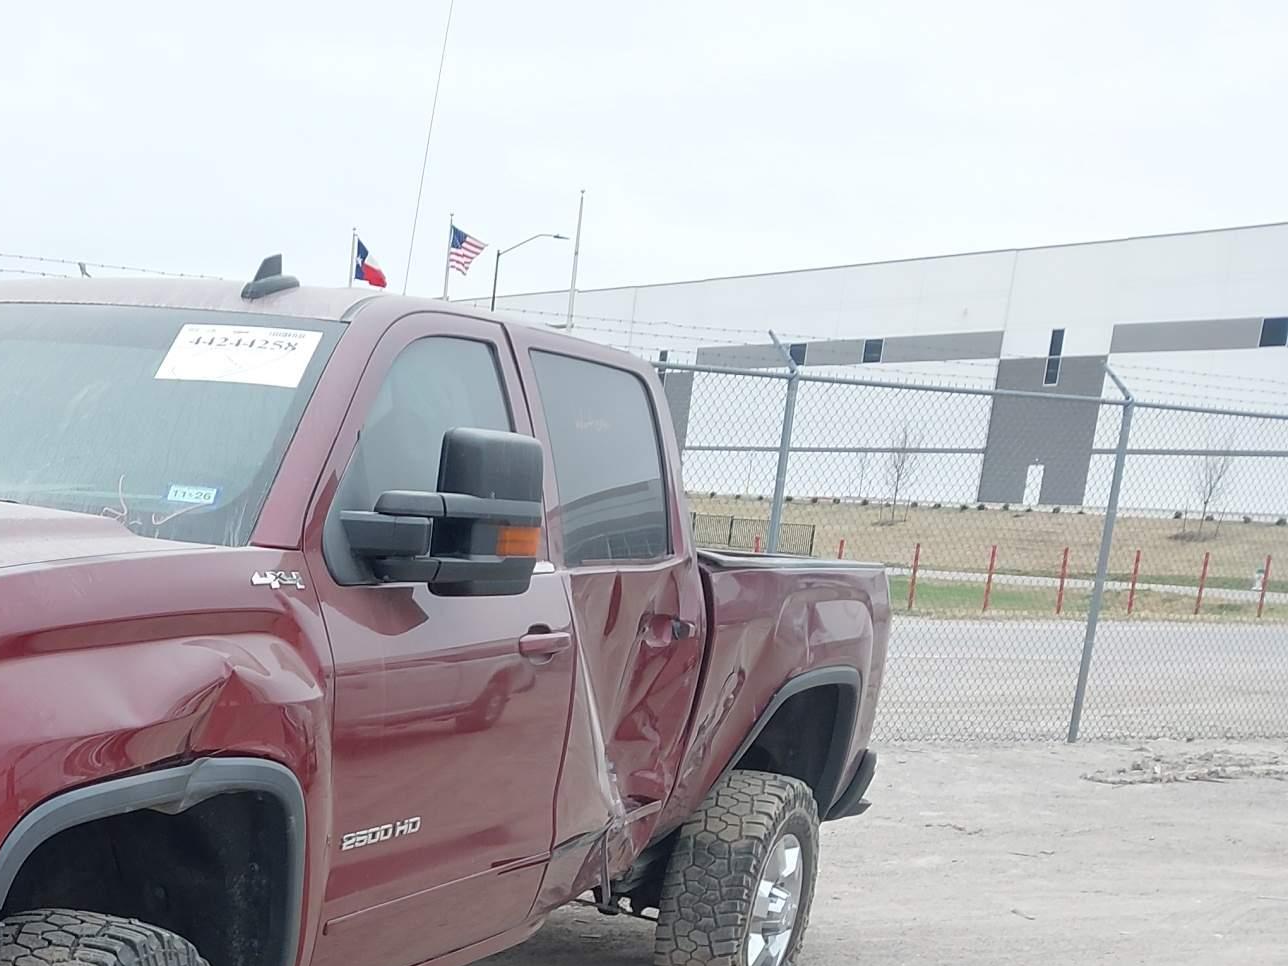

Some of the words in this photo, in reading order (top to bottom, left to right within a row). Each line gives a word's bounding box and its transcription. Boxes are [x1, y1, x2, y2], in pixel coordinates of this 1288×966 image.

[189, 336, 298, 351] 44244258
[341, 823, 393, 851] 2500
[395, 816, 421, 837] HD
